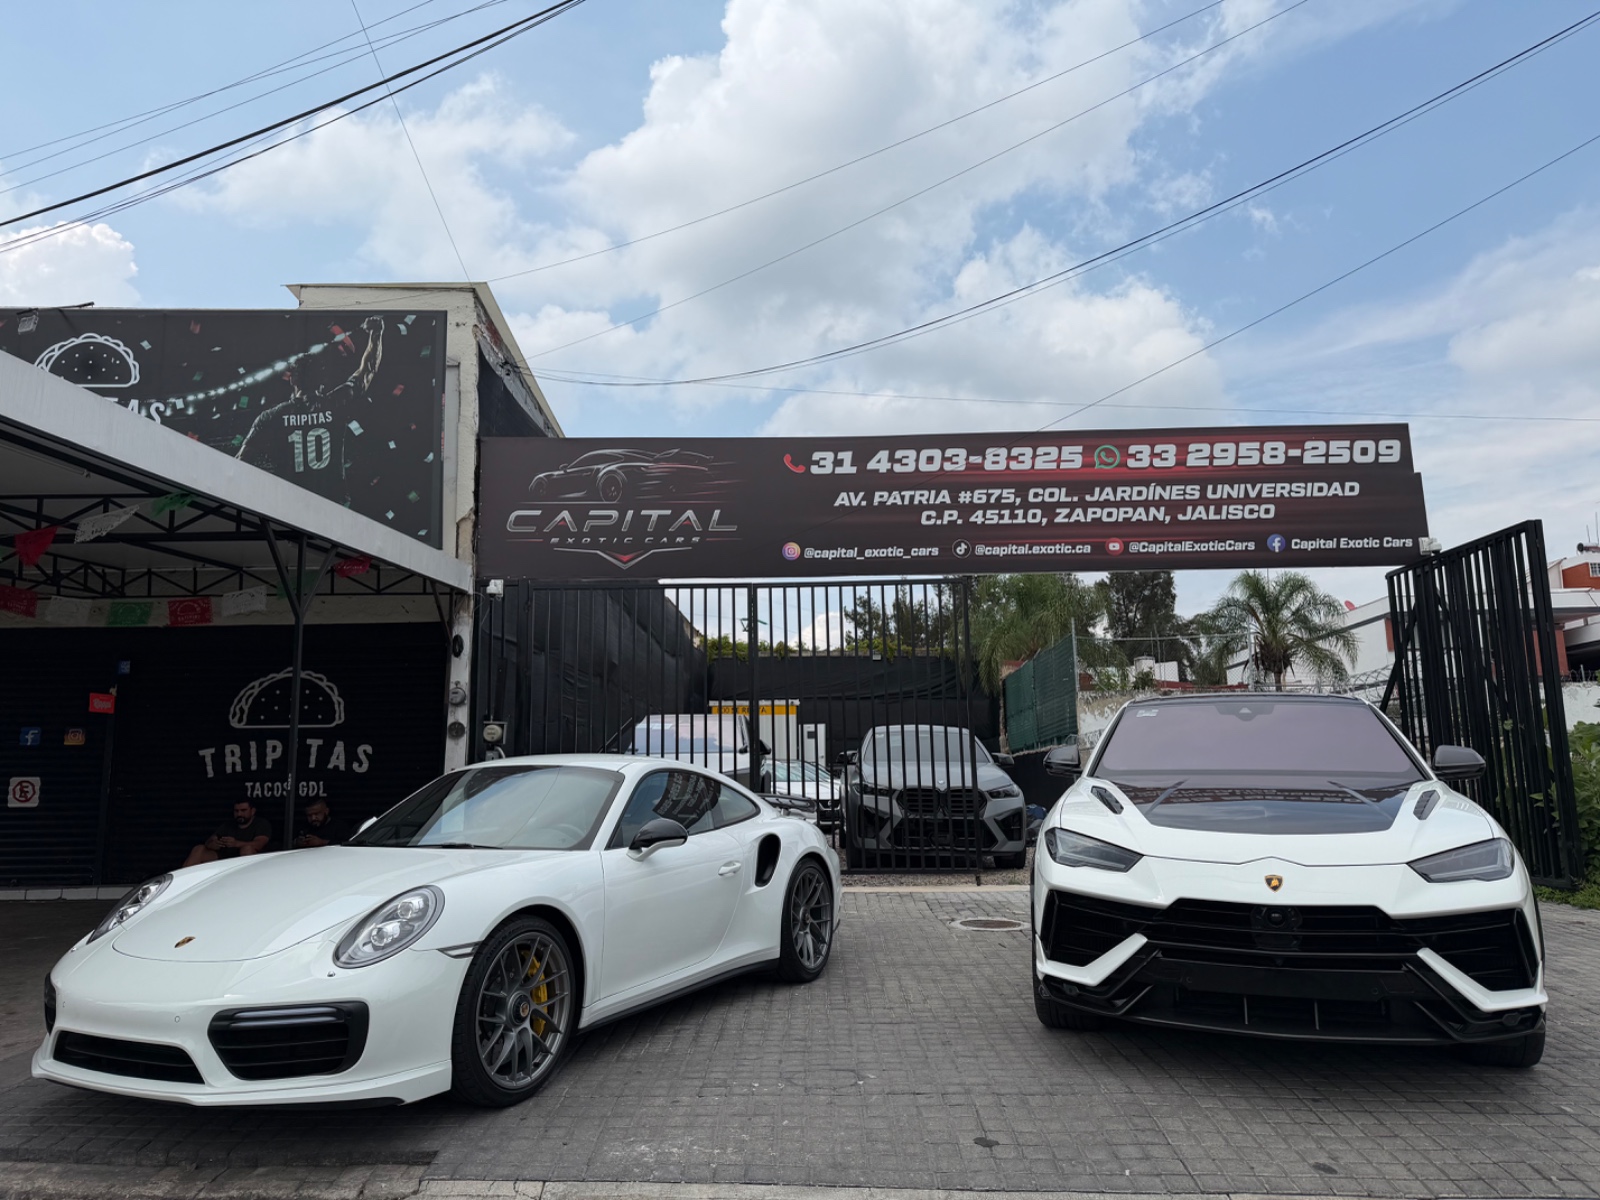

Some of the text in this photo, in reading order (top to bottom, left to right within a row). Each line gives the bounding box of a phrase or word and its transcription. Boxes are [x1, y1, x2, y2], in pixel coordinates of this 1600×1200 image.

[282, 411, 333, 427] TRIPITAS
[287, 428, 331, 473] 10
[810, 445, 1083, 475] 31 4303-8325
[1127, 439, 1401, 468] 33 2958-2509
[834, 481, 1361, 507] AV. PATRIA #675, COL. JARDÍNES UNIVERSIDAD
[506, 509, 738, 532] CAPITAL
[920, 503, 1276, 527] C.P. 45110, ZAPOPAN, JALISCO
[550, 536, 701, 545] EXOTIC CARS
[975, 543, 1092, 557] @capital.exotic.ca
[1128, 540, 1256, 554] @CapitalExoticCars
[1291, 536, 1414, 551] Capital Exotic Cars
[803, 546, 940, 561] @capital_exotic_cars
[198, 738, 373, 778] TRIPTAS
[298, 781, 328, 797] GDL
